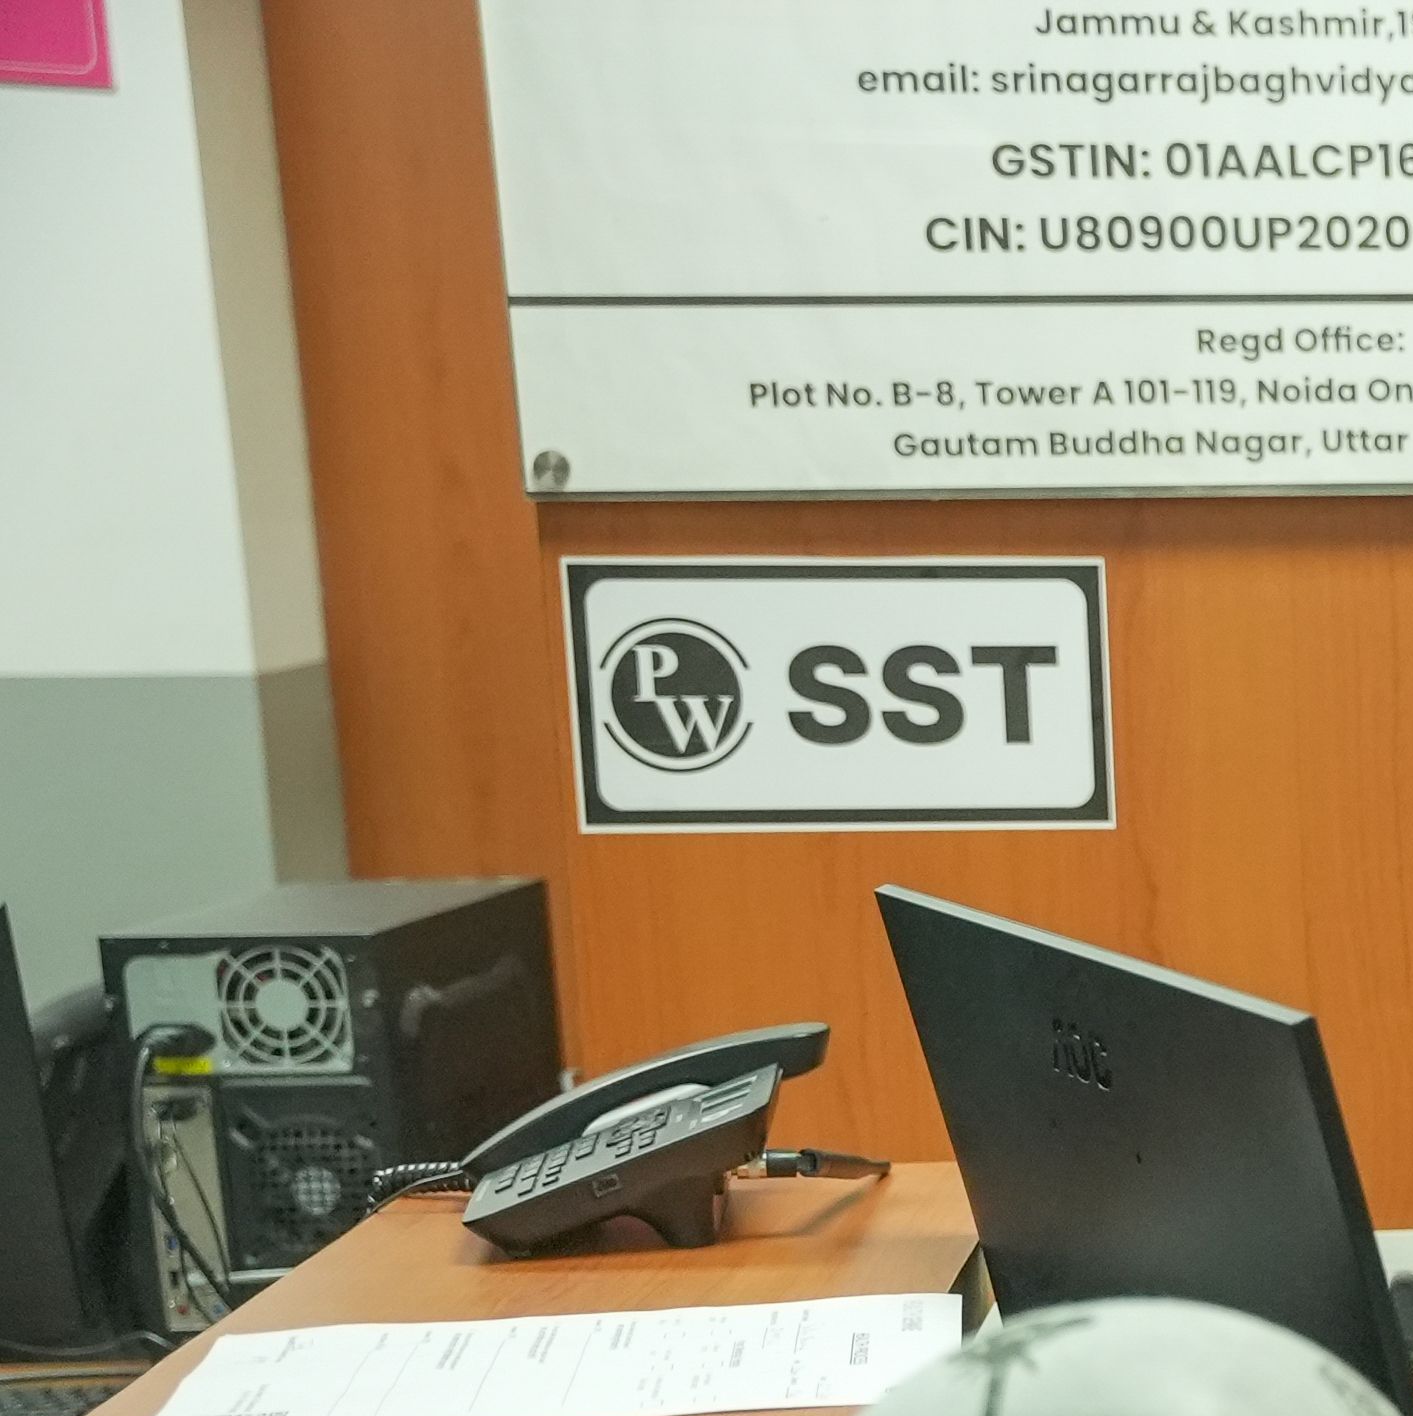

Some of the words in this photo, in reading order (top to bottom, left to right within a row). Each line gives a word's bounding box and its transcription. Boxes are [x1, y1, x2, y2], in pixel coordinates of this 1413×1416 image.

[1034, 7, 1181, 36] Jammu
[1191, 9, 1216, 36] &
[856, 61, 980, 94] email:
[991, 143, 1152, 180] GSTIN:
[925, 216, 1027, 253] CIN:
[1196, 327, 1284, 362] Regd
[1294, 325, 1404, 355] Office:
[749, 380, 818, 409] Plot
[825, 381, 883, 408] No.
[890, 379, 965, 411] B-8,
[974, 380, 1083, 407] Tower
[1092, 380, 1115, 406] A
[1123, 378, 1246, 408] 101-119,
[1257, 376, 1357, 404] Noida
[893, 432, 1040, 458] Gautam
[1048, 429, 1185, 457] Buddha
[1195, 430, 1311, 462] Nagar,
[1322, 428, 1409, 453] Uttar
[788, 645, 1058, 745] SST
